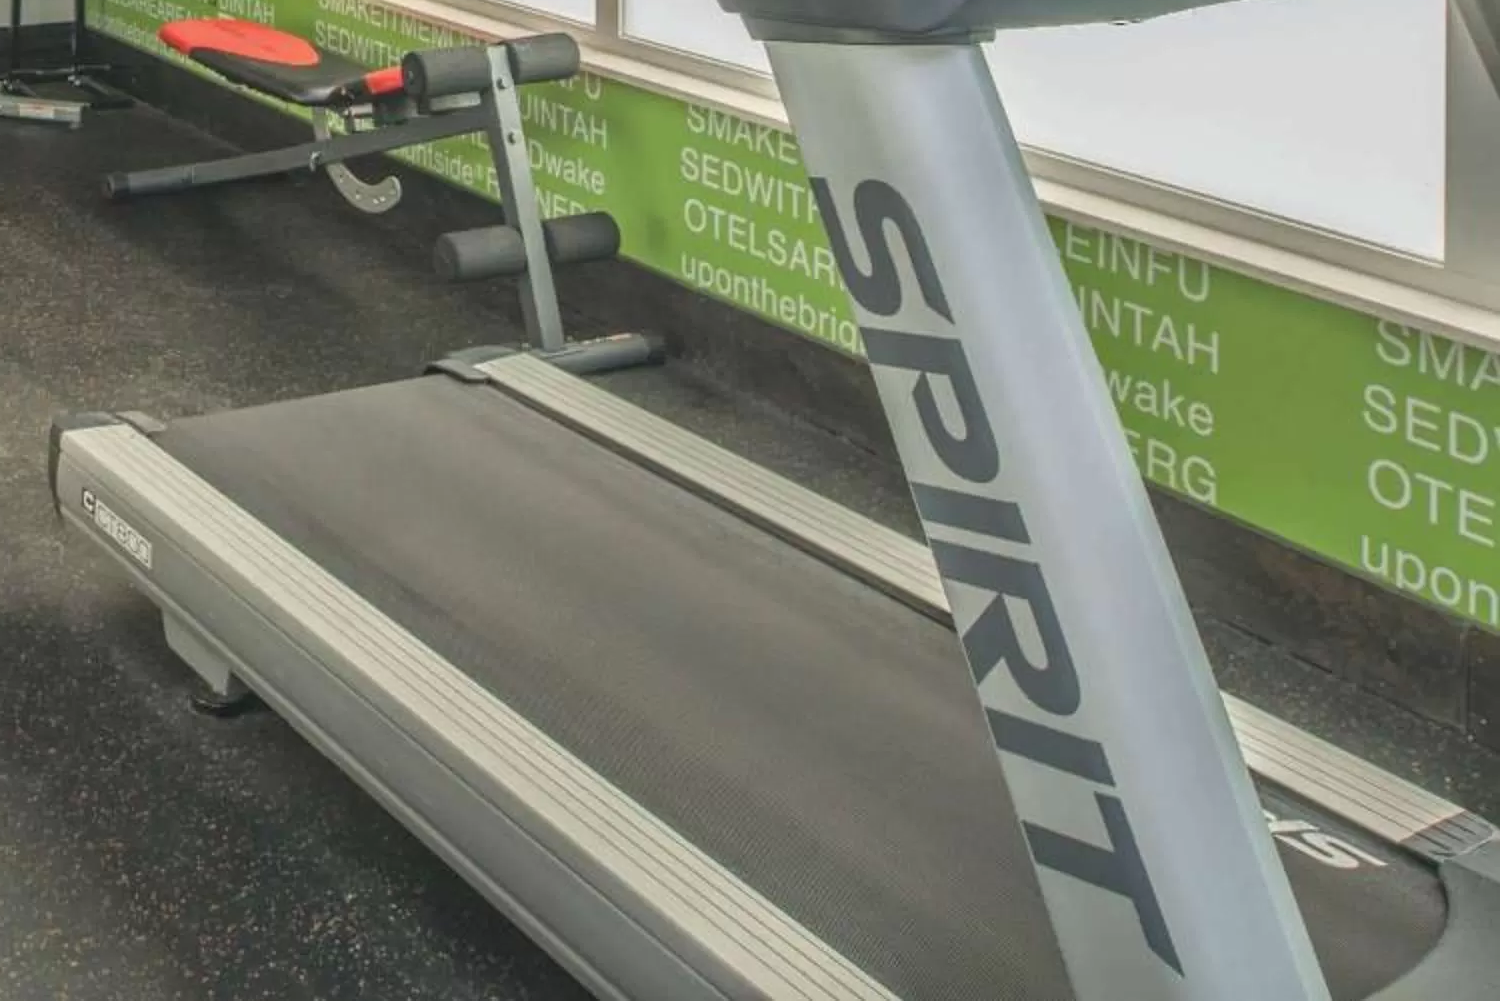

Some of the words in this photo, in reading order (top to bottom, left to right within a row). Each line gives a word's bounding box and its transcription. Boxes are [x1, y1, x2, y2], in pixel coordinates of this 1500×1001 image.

[315, 21, 403, 70] SEDWITH
[684, 198, 844, 291] OTELSAR
[1363, 384, 1500, 465] SED
[1368, 459, 1496, 548] OTE
[810, 176, 1184, 978] SPIRIT
[1361, 534, 1500, 627] upon
